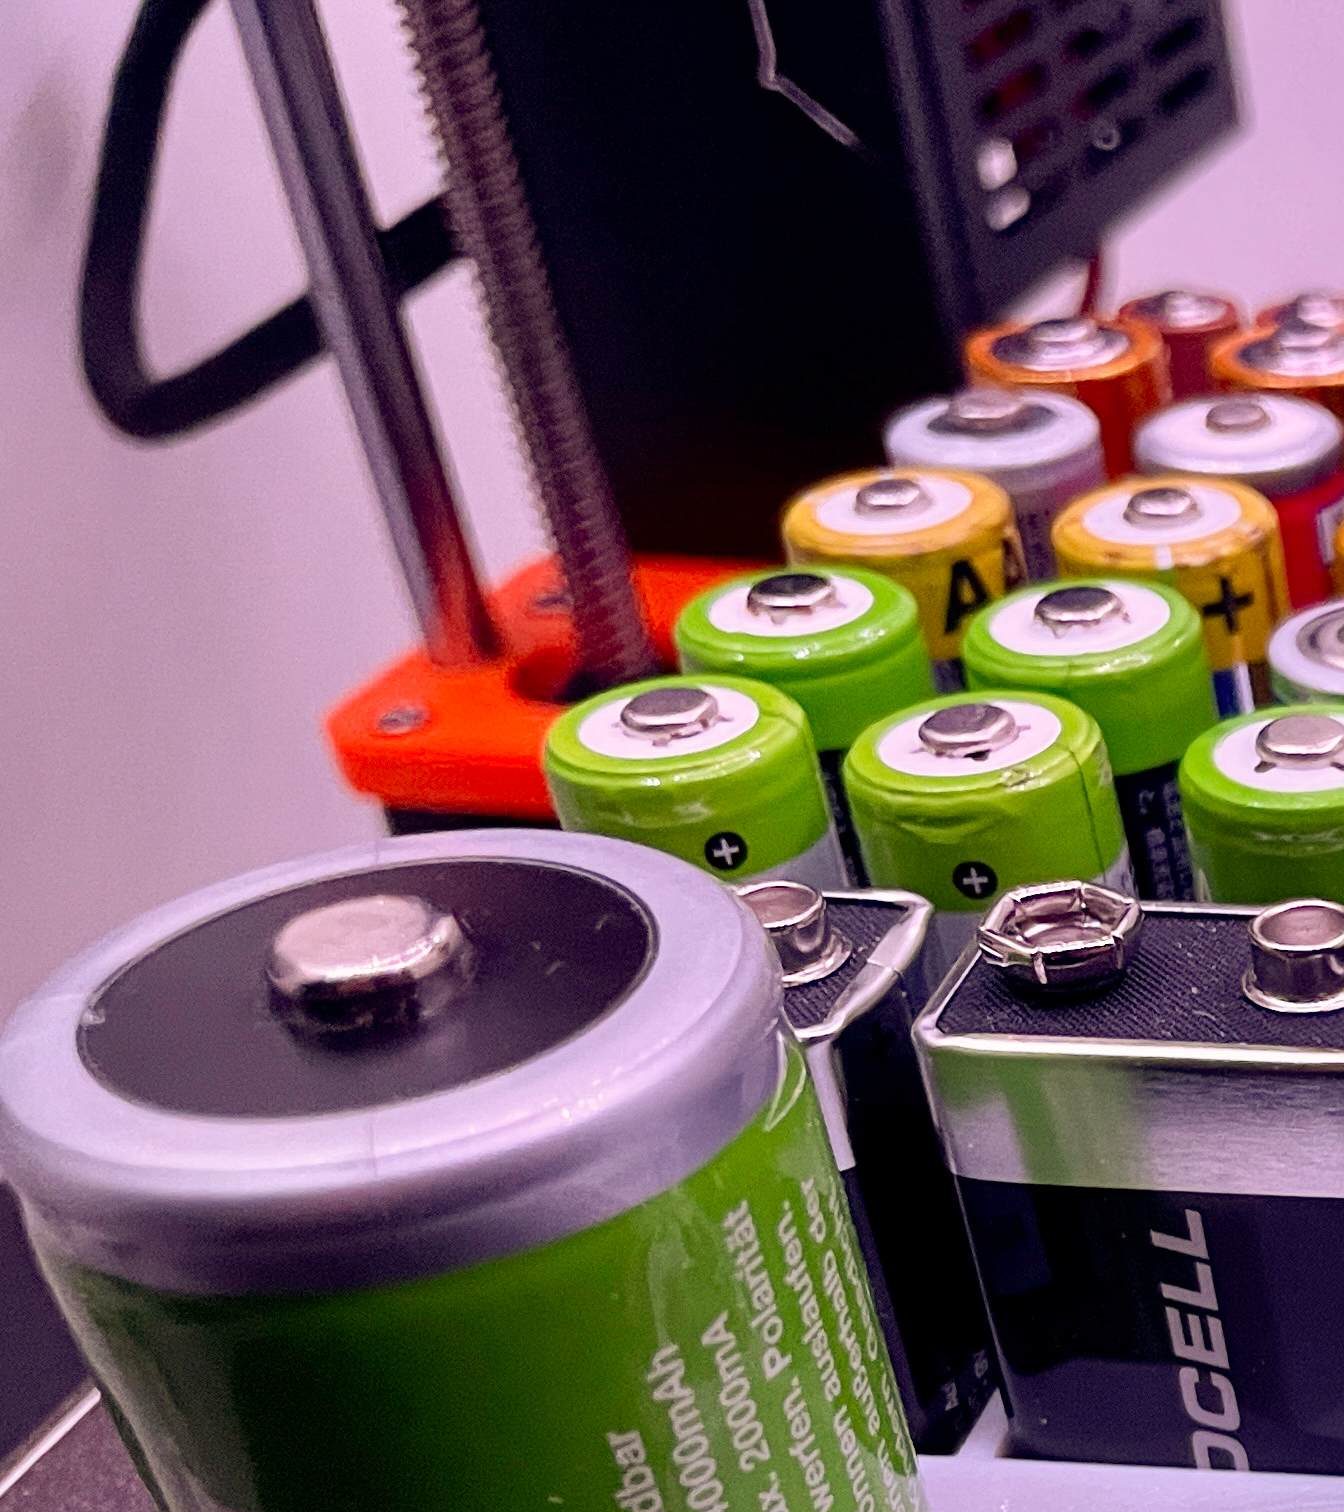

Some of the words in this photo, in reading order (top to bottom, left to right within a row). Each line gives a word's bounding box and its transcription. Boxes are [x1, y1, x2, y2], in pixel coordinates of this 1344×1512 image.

[723, 1199, 794, 1381] Polarität
[776, 1199, 843, 1404] auslaufen.
[822, 1249, 883, 1437] außerhalb
[701, 1310, 772, 1473] 2000mA
